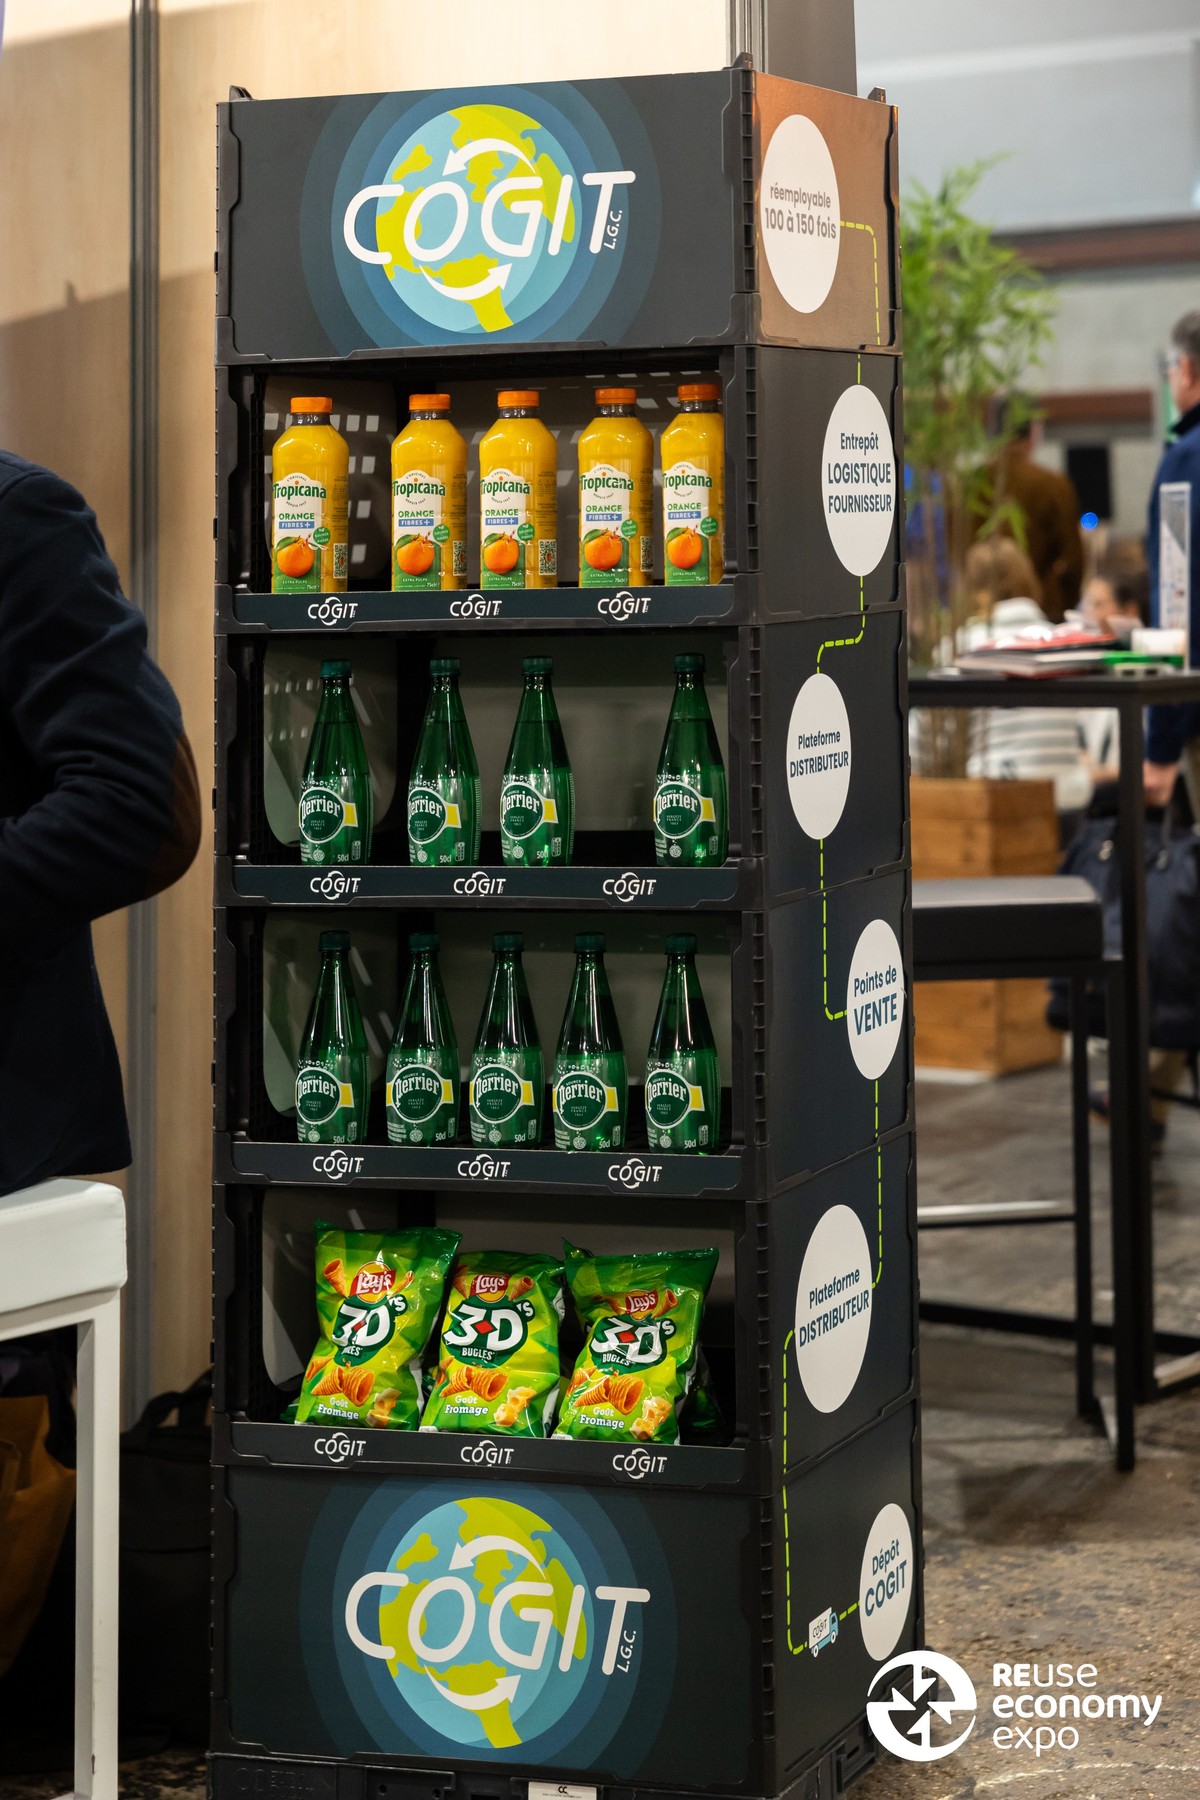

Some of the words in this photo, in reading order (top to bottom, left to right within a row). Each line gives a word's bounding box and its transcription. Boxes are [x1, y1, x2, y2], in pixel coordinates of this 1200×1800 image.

[770, 182, 831, 210] réemployable
[344, 170, 636, 264] COGIT
[765, 208, 784, 230] 100
[786, 210, 794, 232] à
[796, 213, 814, 235] 150
[817, 216, 836, 239] fois
[603, 209, 623, 250] L.G.C.
[840, 432, 878, 456] Entrepôt
[580, 472, 634, 492] Tropicana
[662, 470, 712, 490] Tropicana
[828, 462, 891, 486] LOGISTIQUE
[273, 480, 326, 500] Tropicana
[393, 478, 446, 497] Tropicana
[480, 476, 530, 496] Tropicana
[828, 494, 892, 513] FOURNISSEUR
[308, 603, 358, 618] COGIT
[450, 601, 502, 618] COGIT
[598, 598, 651, 614] COGIT
[798, 730, 840, 750] Plateforme
[790, 751, 848, 778] DISTRIBUTEUR
[310, 878, 361, 893] COGIT
[454, 878, 506, 894] COGIT
[603, 879, 656, 895] COGIT
[854, 971, 883, 997] Points
[885, 965, 897, 985] de
[854, 993, 897, 1035] VENTE
[333, 1135, 345, 1144] 50cl
[684, 1139, 696, 1148] 50cl
[313, 1156, 364, 1173] COGIT
[458, 1161, 510, 1177] COGIT
[608, 1165, 662, 1182] COGIT
[809, 1269, 860, 1309] Plateforme
[800, 1290, 869, 1347] DISTRIBUTEUR
[462, 1348, 492, 1360] BUGLES
[602, 1354, 630, 1366] BUGLES
[329, 1397, 348, 1408] Goût
[455, 1395, 478, 1404] Goût
[317, 1404, 359, 1420] Fromage
[445, 1404, 488, 1415] Fromage
[593, 1407, 614, 1417] Goût
[580, 1415, 624, 1428] Fromage
[314, 1438, 366, 1456] COGIT
[460, 1446, 514, 1464] COGIT
[612, 1454, 668, 1473] COGIT
[872, 1539, 899, 1576] Dépôt
[865, 1560, 907, 1617] COGIT
[345, 1571, 651, 1675] COGIT
[617, 1630, 637, 1673] L.G.C.
